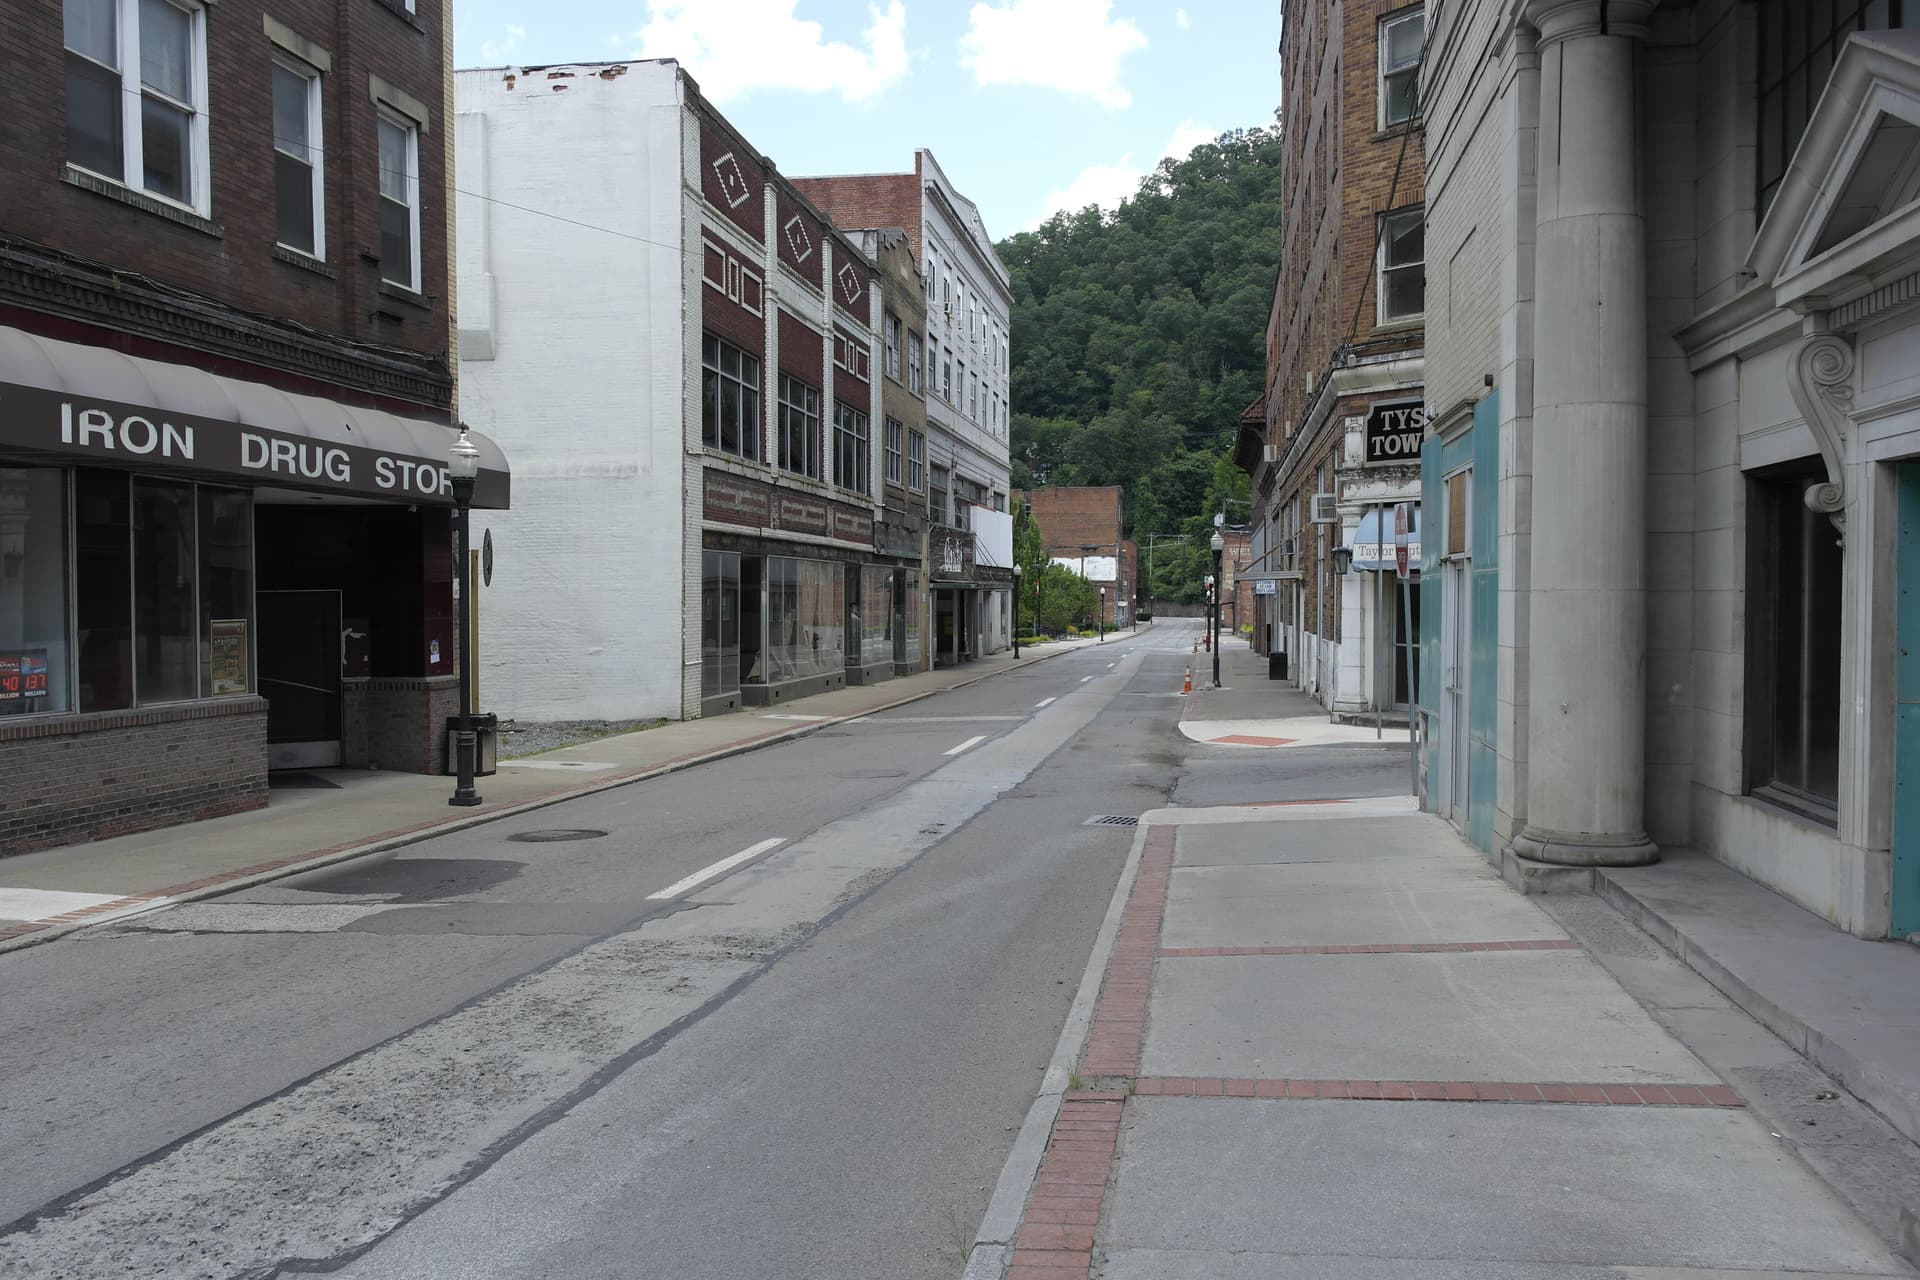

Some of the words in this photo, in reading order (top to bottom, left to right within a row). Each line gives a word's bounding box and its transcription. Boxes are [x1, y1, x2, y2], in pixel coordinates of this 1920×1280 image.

[1381, 407, 1424, 431] TYS
[61, 402, 195, 460] IRON
[241, 431, 351, 483] DRUG
[375, 456, 473, 497] STOR
[1359, 545, 1395, 559] Tayor
[25, 674, 46, 689] 137
